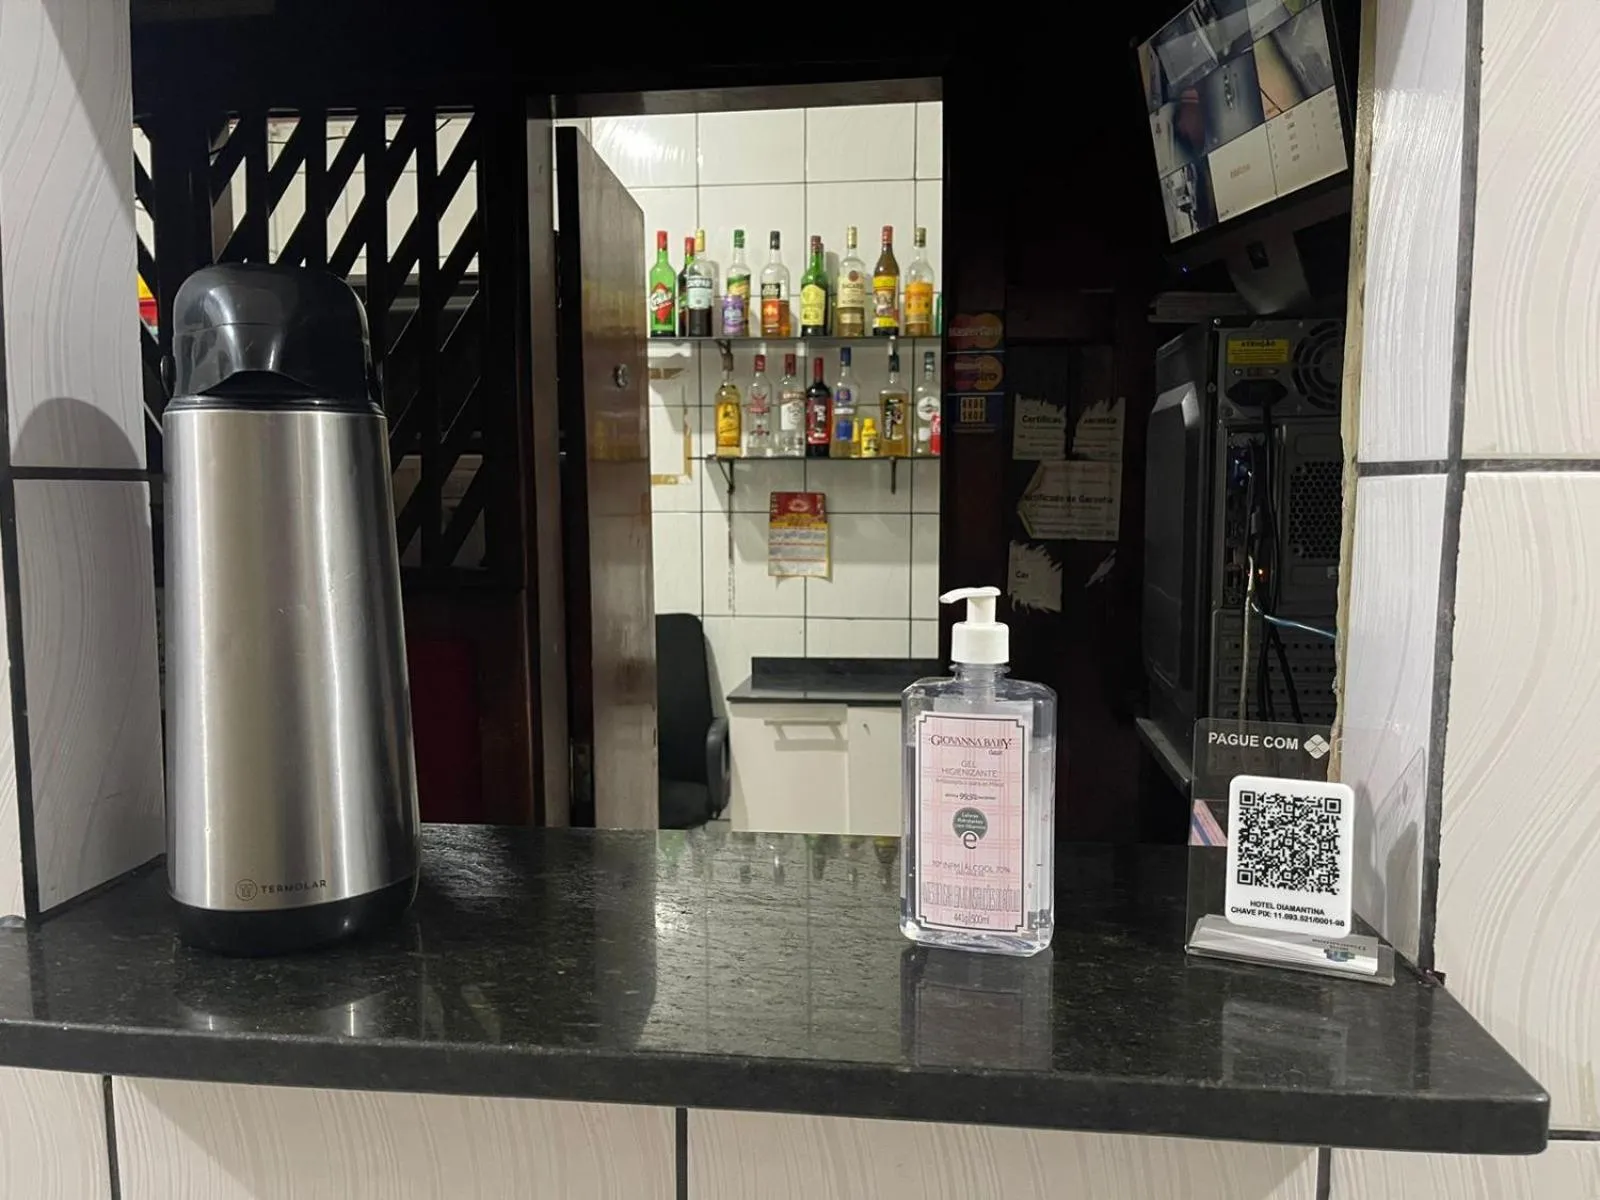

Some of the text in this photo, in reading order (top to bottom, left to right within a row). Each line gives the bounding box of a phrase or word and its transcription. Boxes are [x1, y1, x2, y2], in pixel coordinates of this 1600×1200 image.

[930, 734, 1012, 750] GIOVANNA BABY
[1208, 732, 1299, 751] PAGUE COM
[960, 760, 977, 769] GEL
[941, 767, 998, 778] HIGIENIZANTE
[962, 831, 977, 850] e
[261, 880, 328, 894] TERMOLAR
[1230, 906, 1256, 916] CHAVE
[1250, 900, 1325, 916] HOTEL DIAMANTINA
